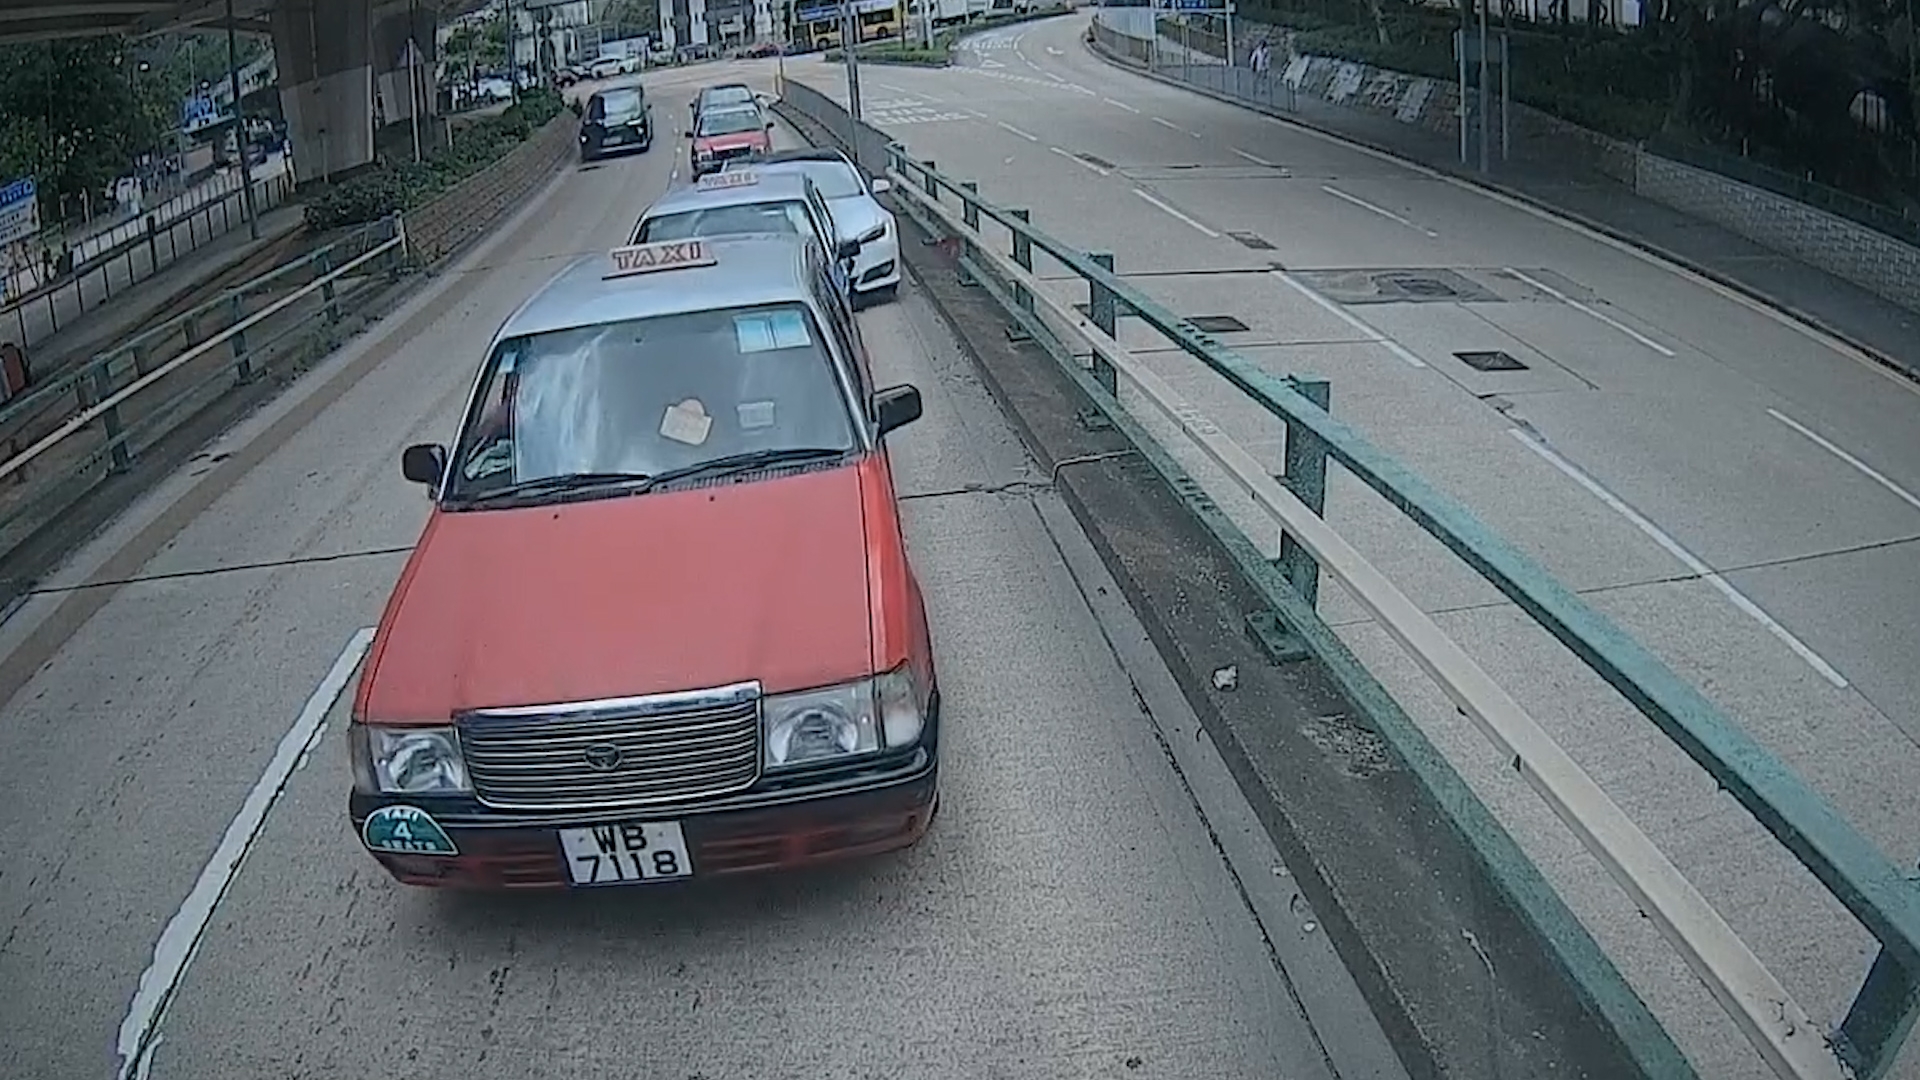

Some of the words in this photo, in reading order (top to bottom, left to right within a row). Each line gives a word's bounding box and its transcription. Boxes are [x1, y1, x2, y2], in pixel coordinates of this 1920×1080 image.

[612, 242, 702, 270] TAXI
[382, 809, 419, 822] TAXI
[393, 821, 412, 840] 4
[593, 825, 647, 854] WB
[381, 840, 437, 851] SEATS
[576, 850, 679, 883] 7118
